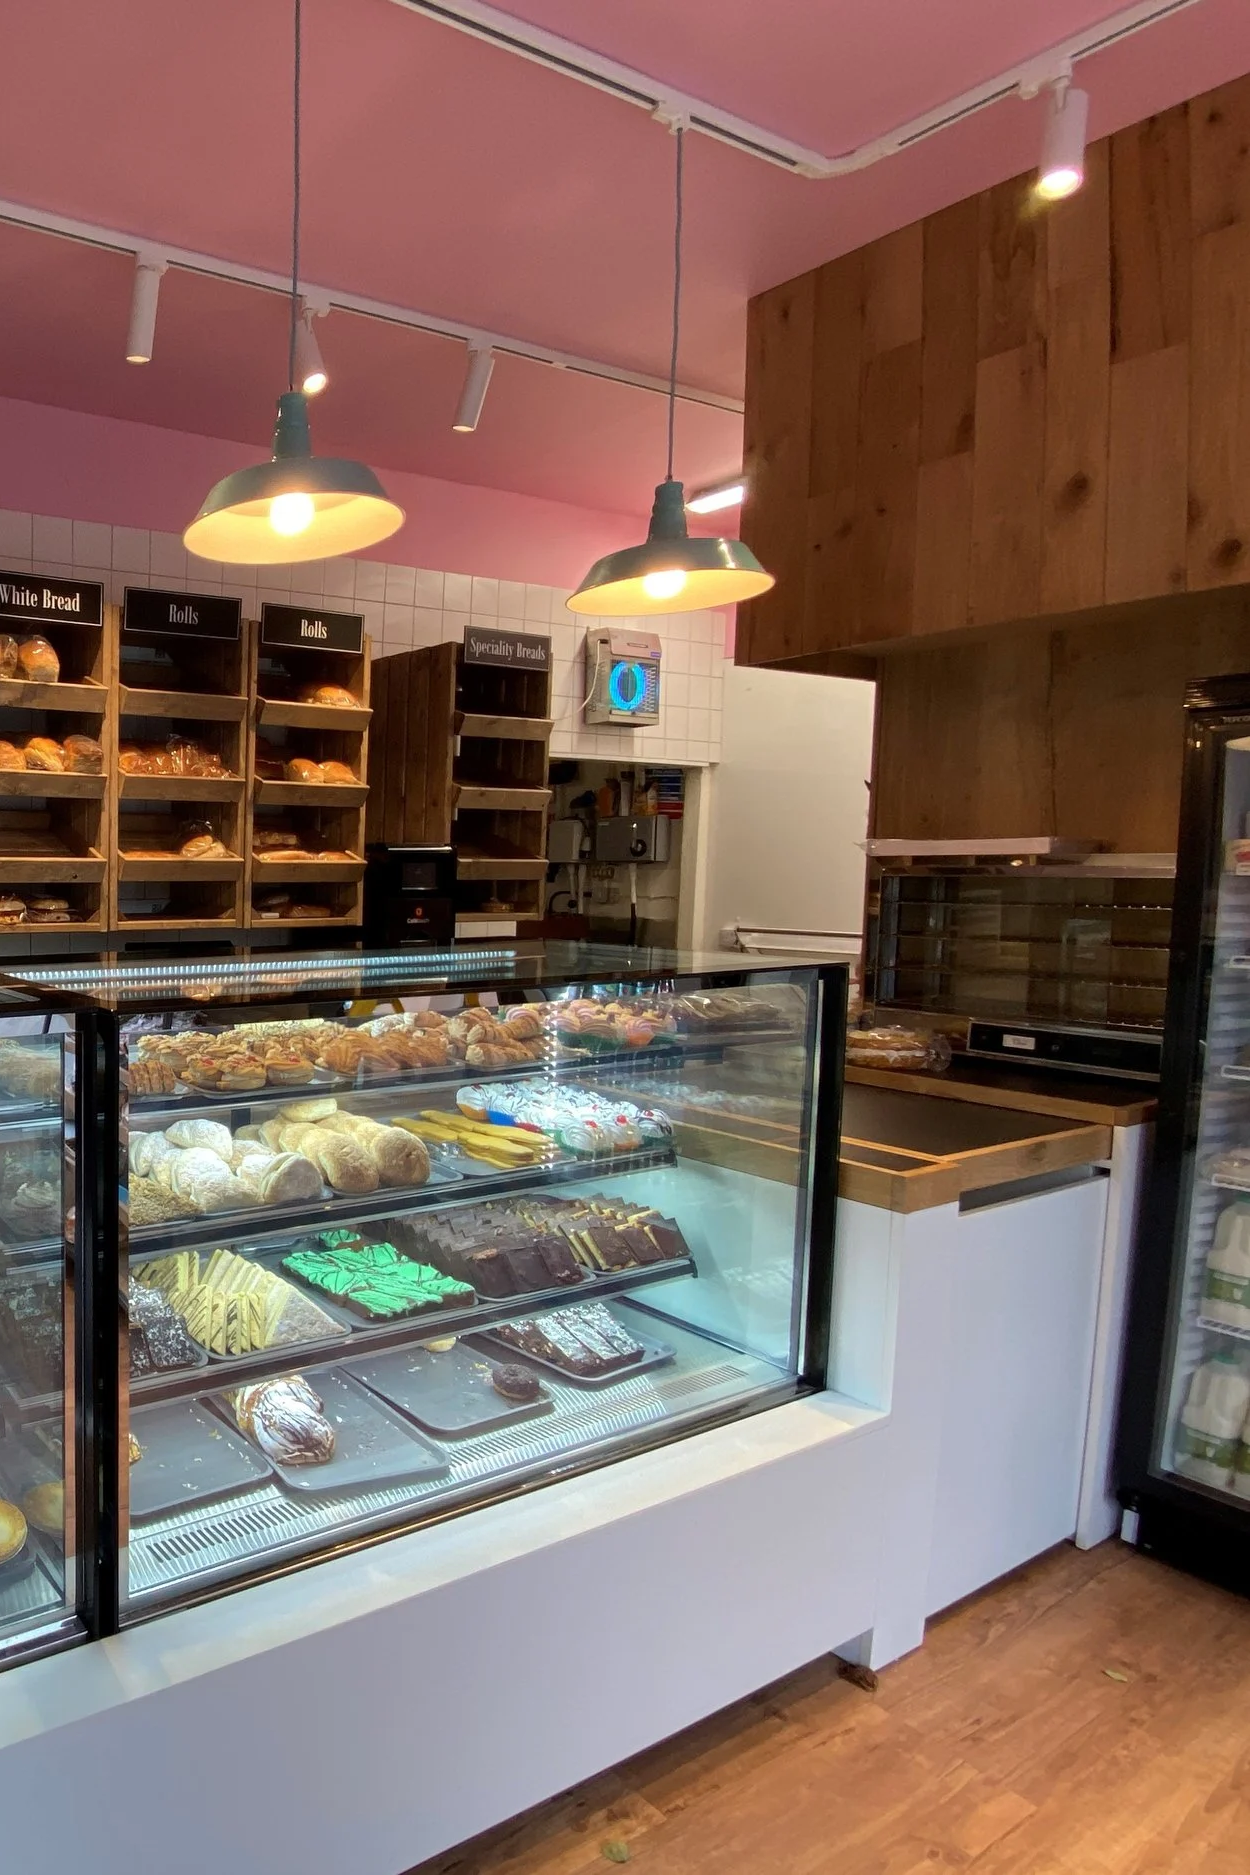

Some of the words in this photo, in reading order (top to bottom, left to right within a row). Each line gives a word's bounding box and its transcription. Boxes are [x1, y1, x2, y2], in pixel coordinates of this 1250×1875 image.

[43, 588, 81, 612] Bread
[169, 603, 199, 625] Rolls
[300, 619, 328, 639] Rolls
[470, 637, 515, 661] Speciality
[516, 642, 546, 661] Breads
